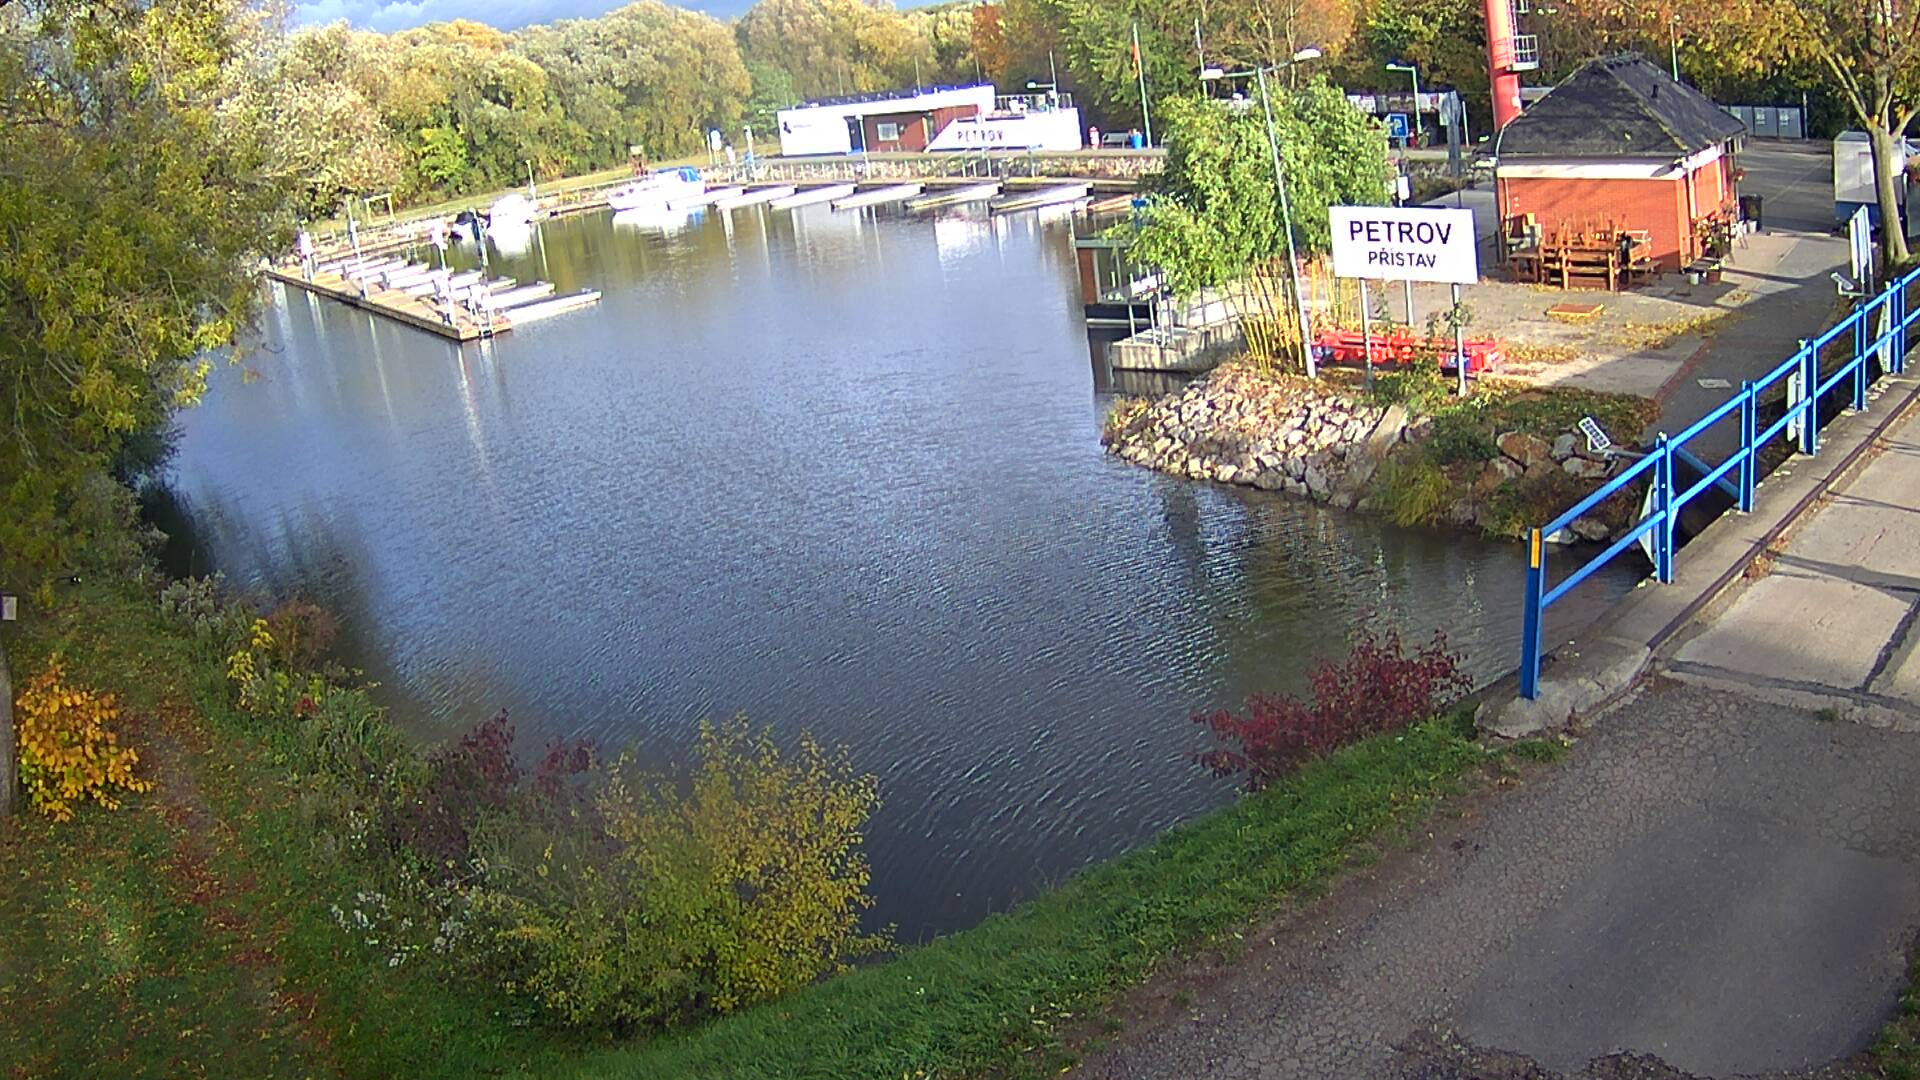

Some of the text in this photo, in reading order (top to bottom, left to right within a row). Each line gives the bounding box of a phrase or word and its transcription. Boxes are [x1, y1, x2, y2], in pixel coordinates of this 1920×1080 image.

[957, 129, 1003, 142] PETROV
[1393, 118, 1403, 137] P
[1349, 220, 1452, 245] PETROV
[1367, 247, 1437, 269] PŘÍSTAV
